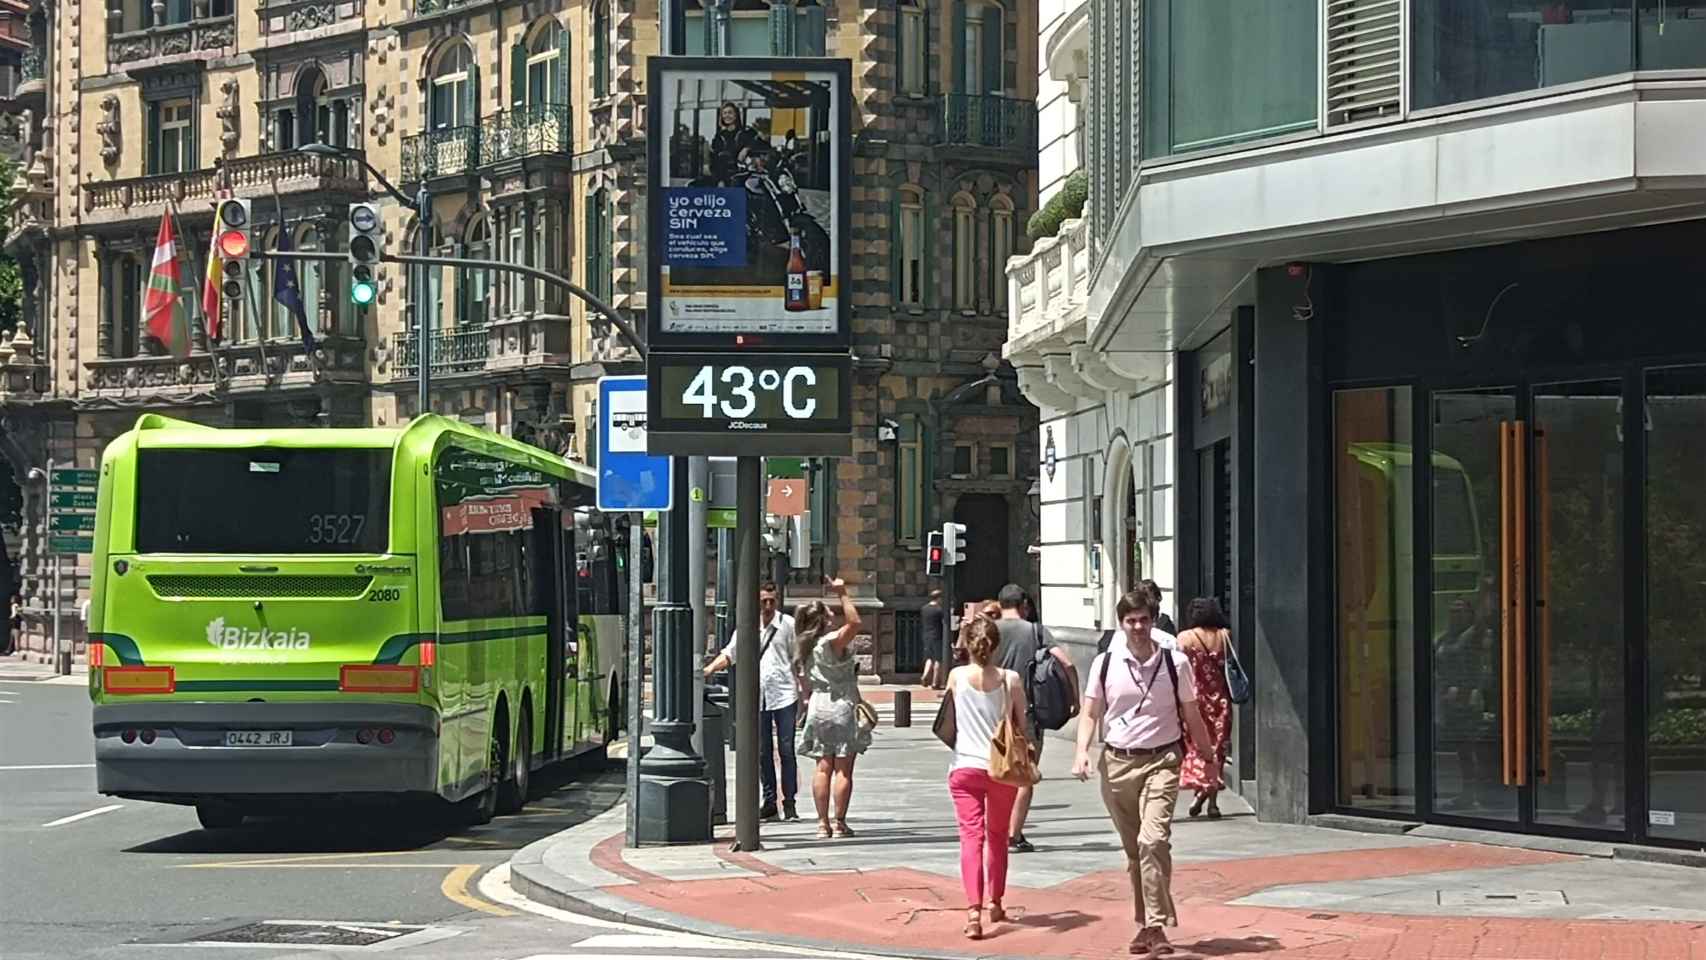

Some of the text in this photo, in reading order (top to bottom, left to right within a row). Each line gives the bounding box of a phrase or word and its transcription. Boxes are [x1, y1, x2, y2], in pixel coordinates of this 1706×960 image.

[670, 194, 726, 208] yo elijo
[669, 209, 731, 218] cerveza
[669, 218, 697, 229] SIN
[682, 365, 816, 419] 43°C
[728, 421, 768, 430] JCDecaux
[368, 588, 400, 602] 2080
[223, 627, 311, 649] Bizkaia
[228, 732, 290, 745] 0442 JRJ
